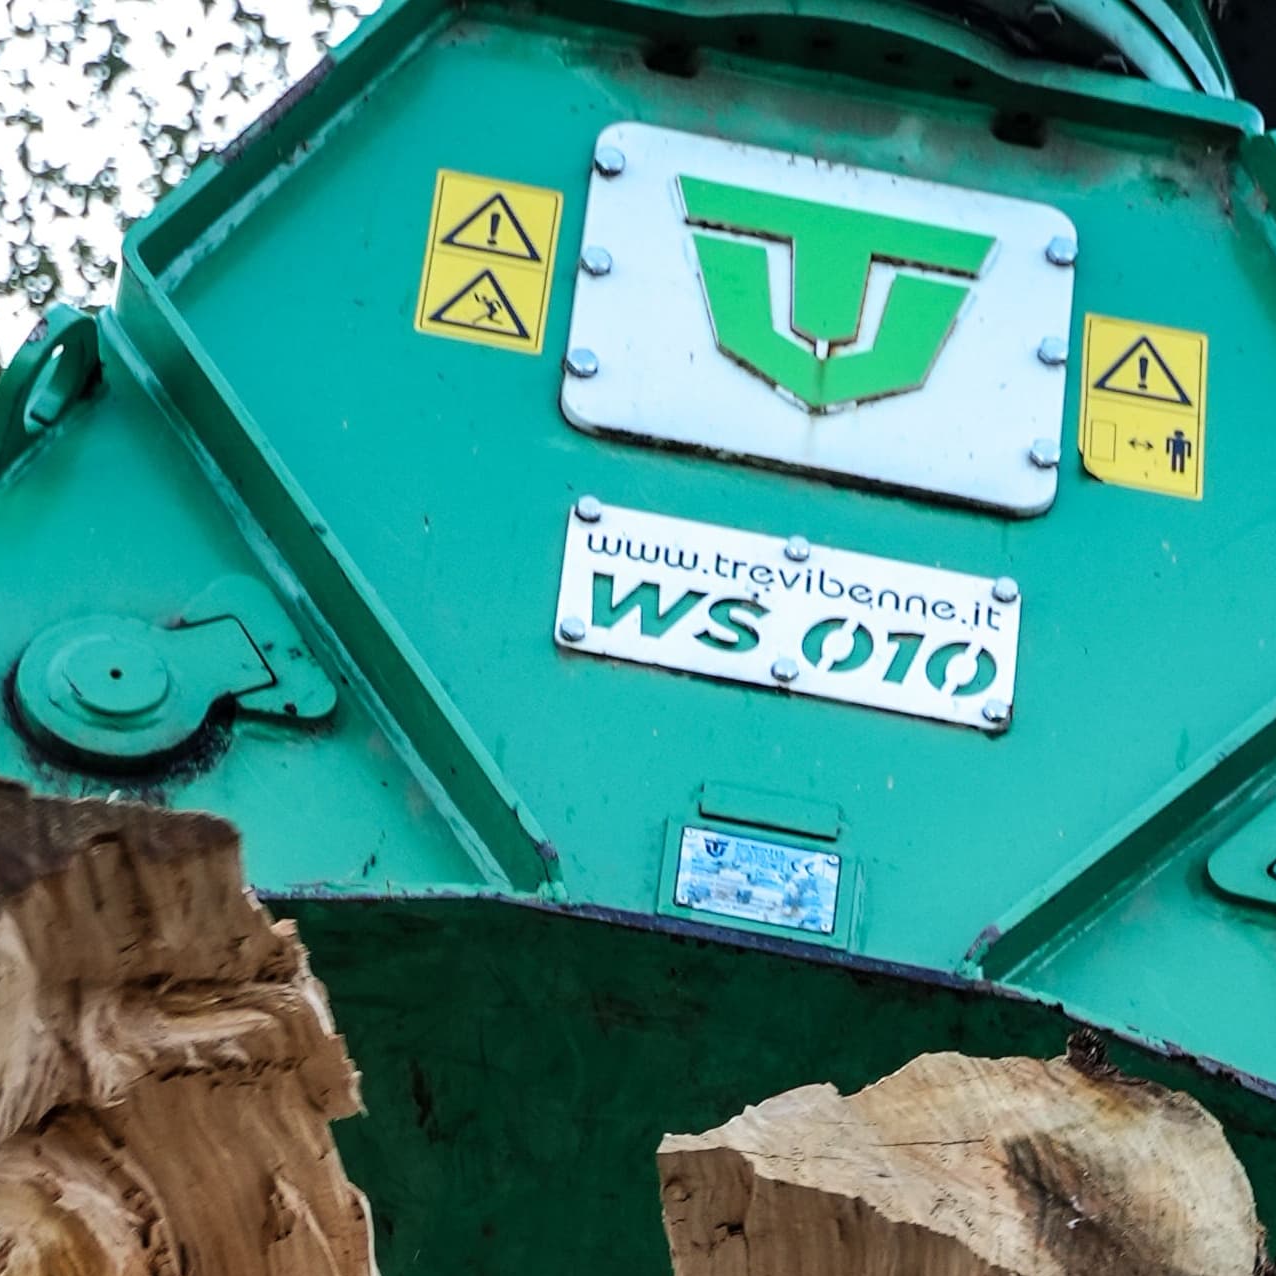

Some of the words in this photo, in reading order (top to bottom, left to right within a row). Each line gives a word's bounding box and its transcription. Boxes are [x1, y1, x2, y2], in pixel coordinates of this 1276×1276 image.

[586, 532, 1002, 632] www.trevibenne.it
[591, 571, 771, 653] WS
[801, 616, 998, 697] 010
